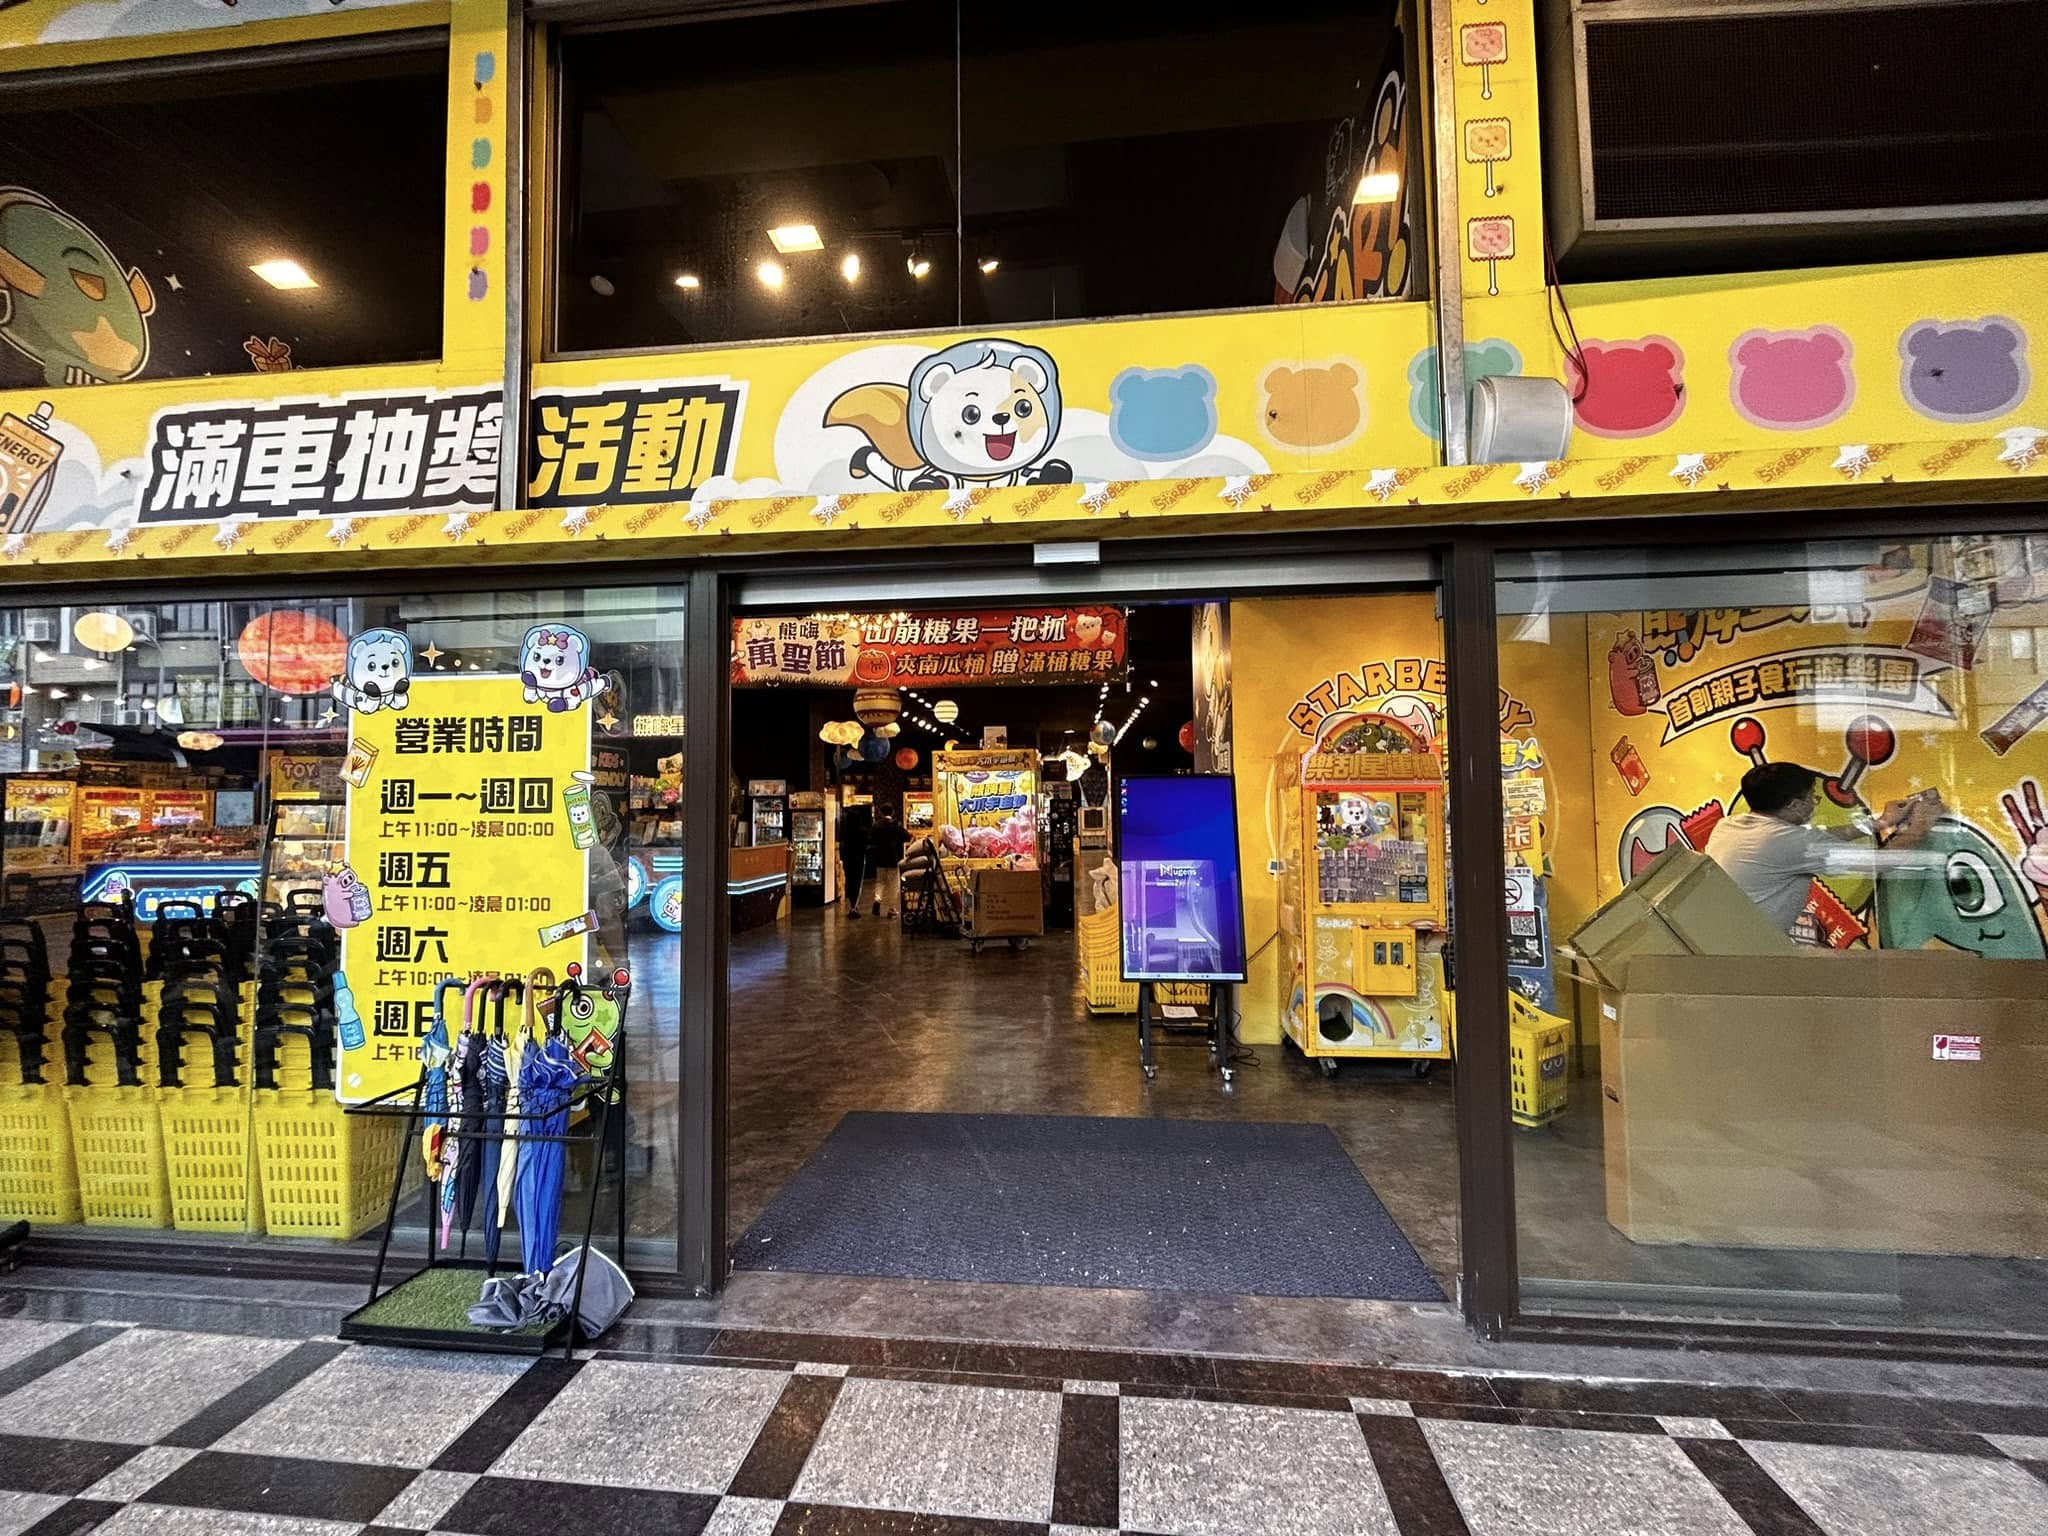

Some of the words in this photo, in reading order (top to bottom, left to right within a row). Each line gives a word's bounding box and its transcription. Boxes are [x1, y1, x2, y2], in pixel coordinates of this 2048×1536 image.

[150, 398, 724, 508] 滿車抽獎活動
[778, 621, 820, 641] 熊嗨
[864, 615, 1067, 645] 山崩糖果一把抓
[746, 637, 847, 675] 萬聖節
[1287, 658, 1535, 736] STARBEY
[395, 715, 543, 754] 營業時間
[380, 777, 553, 815] 週一~週四
[378, 852, 451, 888] 週五
[375, 926, 449, 963] 週六
